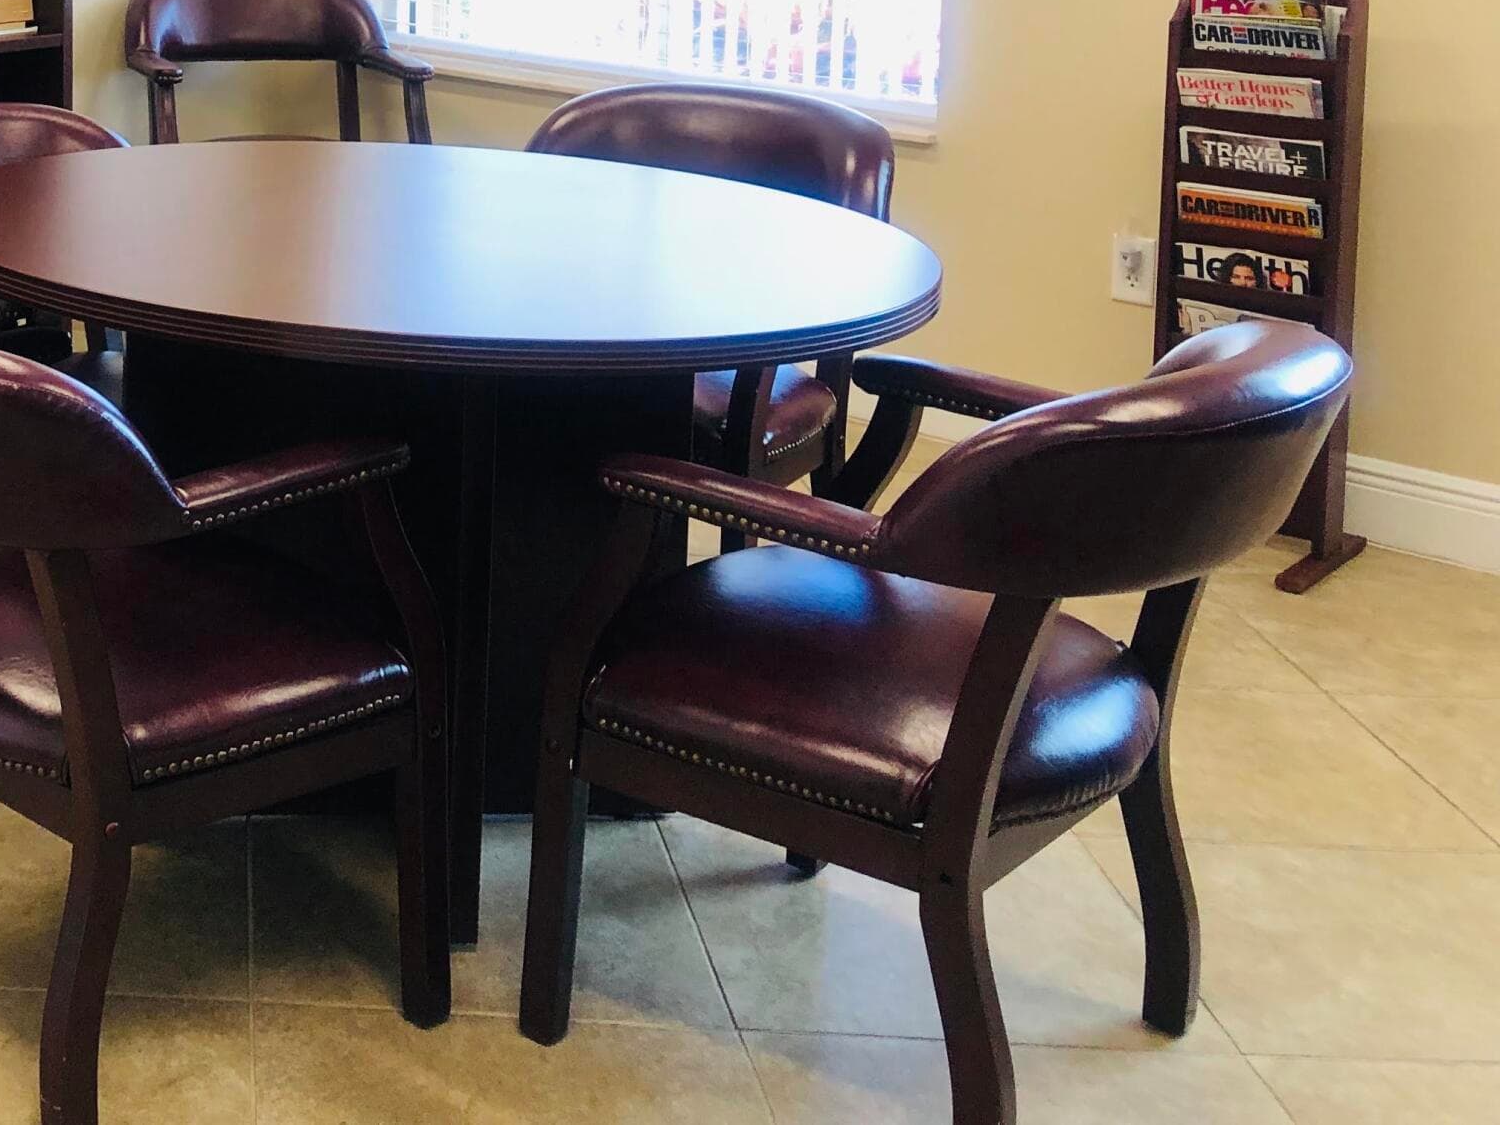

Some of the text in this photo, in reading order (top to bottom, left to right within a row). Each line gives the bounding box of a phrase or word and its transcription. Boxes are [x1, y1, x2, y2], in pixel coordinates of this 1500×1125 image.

[1194, 23, 1321, 50] CAR DRIVER
[1179, 75, 1306, 97] Better Homes
[1215, 93, 1294, 109] Gardens
[1181, 195, 1305, 227] CAR DRIVER
[1176, 243, 1311, 295] Helth
